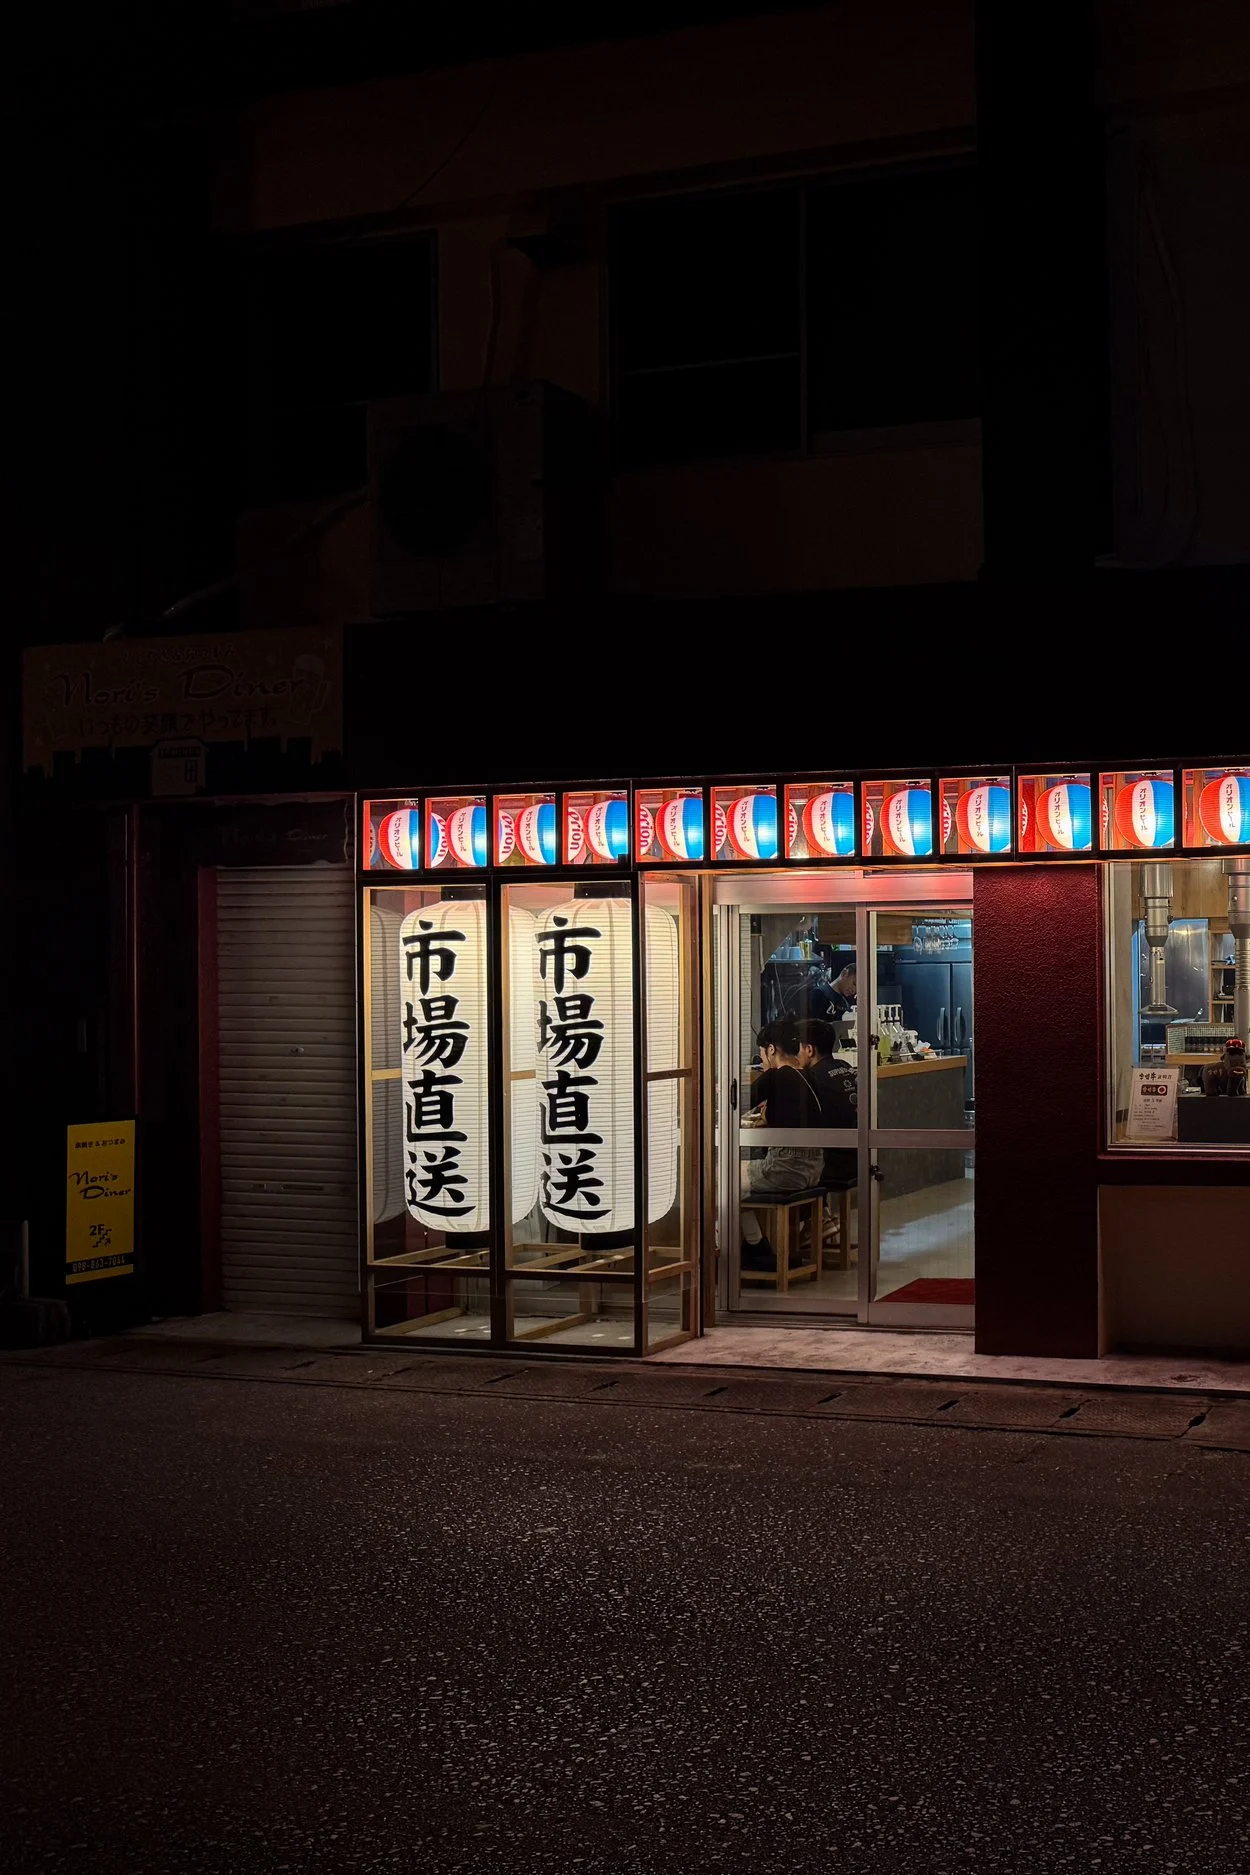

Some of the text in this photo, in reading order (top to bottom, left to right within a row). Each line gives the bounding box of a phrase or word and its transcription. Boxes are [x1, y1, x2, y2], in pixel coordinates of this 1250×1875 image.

[50, 663, 305, 707] Nori's Diner
[670, 805, 680, 846] オリオンビール
[740, 801, 750, 842] オリオンビール
[820, 801, 830, 842] オリオンビール
[895, 799, 906, 843] オリオンビール
[975, 794, 984, 837] オリオンビール
[1054, 791, 1064, 835] オリオンビール
[1140, 788, 1148, 831] オリオンビール
[1226, 784, 1236, 828] オリオンビール
[394, 817, 403, 857] オリオンビール
[458, 812, 467, 852] オリオンビール
[501, 815, 514, 854] Orion
[525, 811, 535, 851] オリオンビール
[568, 811, 584, 850] Orion
[595, 807, 604, 848] オリオンビール
[402, 919, 477, 1218] 市場直送
[535, 915, 613, 1221] 市場直送
[68, 1170, 118, 1185] Nori's
[79, 1185, 132, 1199] Diner
[90, 1224, 104, 1236] 2F
